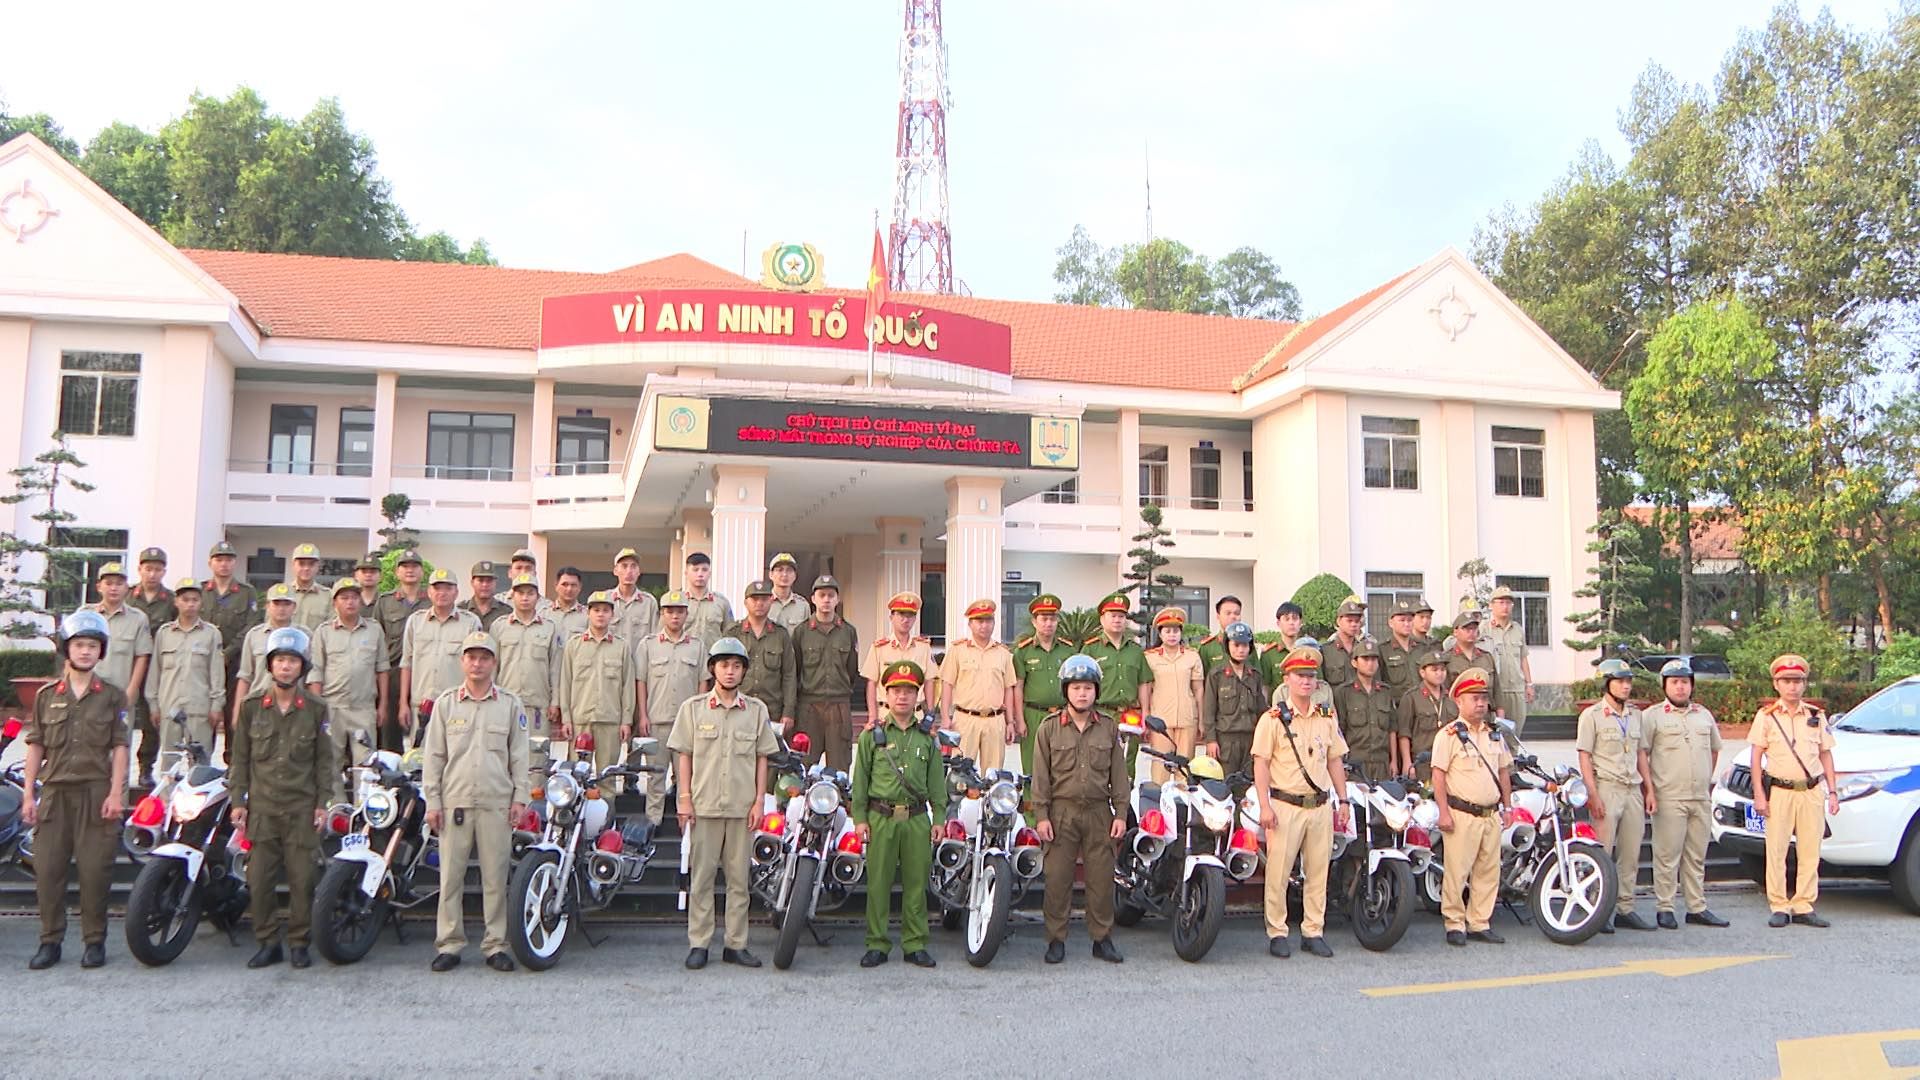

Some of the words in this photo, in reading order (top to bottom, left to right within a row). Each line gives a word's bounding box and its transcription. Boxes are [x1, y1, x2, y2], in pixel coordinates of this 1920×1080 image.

[612, 295, 646, 333] VÌ
[655, 302, 704, 333] AN
[718, 303, 794, 336] NINH
[808, 298, 848, 339] TỔ
[864, 309, 938, 351] QUỐC
[787, 413, 817, 427] CHỦ
[818, 415, 849, 431] TỊCH
[873, 418, 897, 432] CHÍ
[898, 420, 934, 435] MINH
[807, 431, 853, 445] TRONG
[855, 432, 876, 448] SỰ
[876, 434, 924, 451] NGHIỆP
[925, 435, 954, 451] CỦA
[955, 437, 1001, 453] CHÚNG
[1002, 441, 1021, 454] TA
